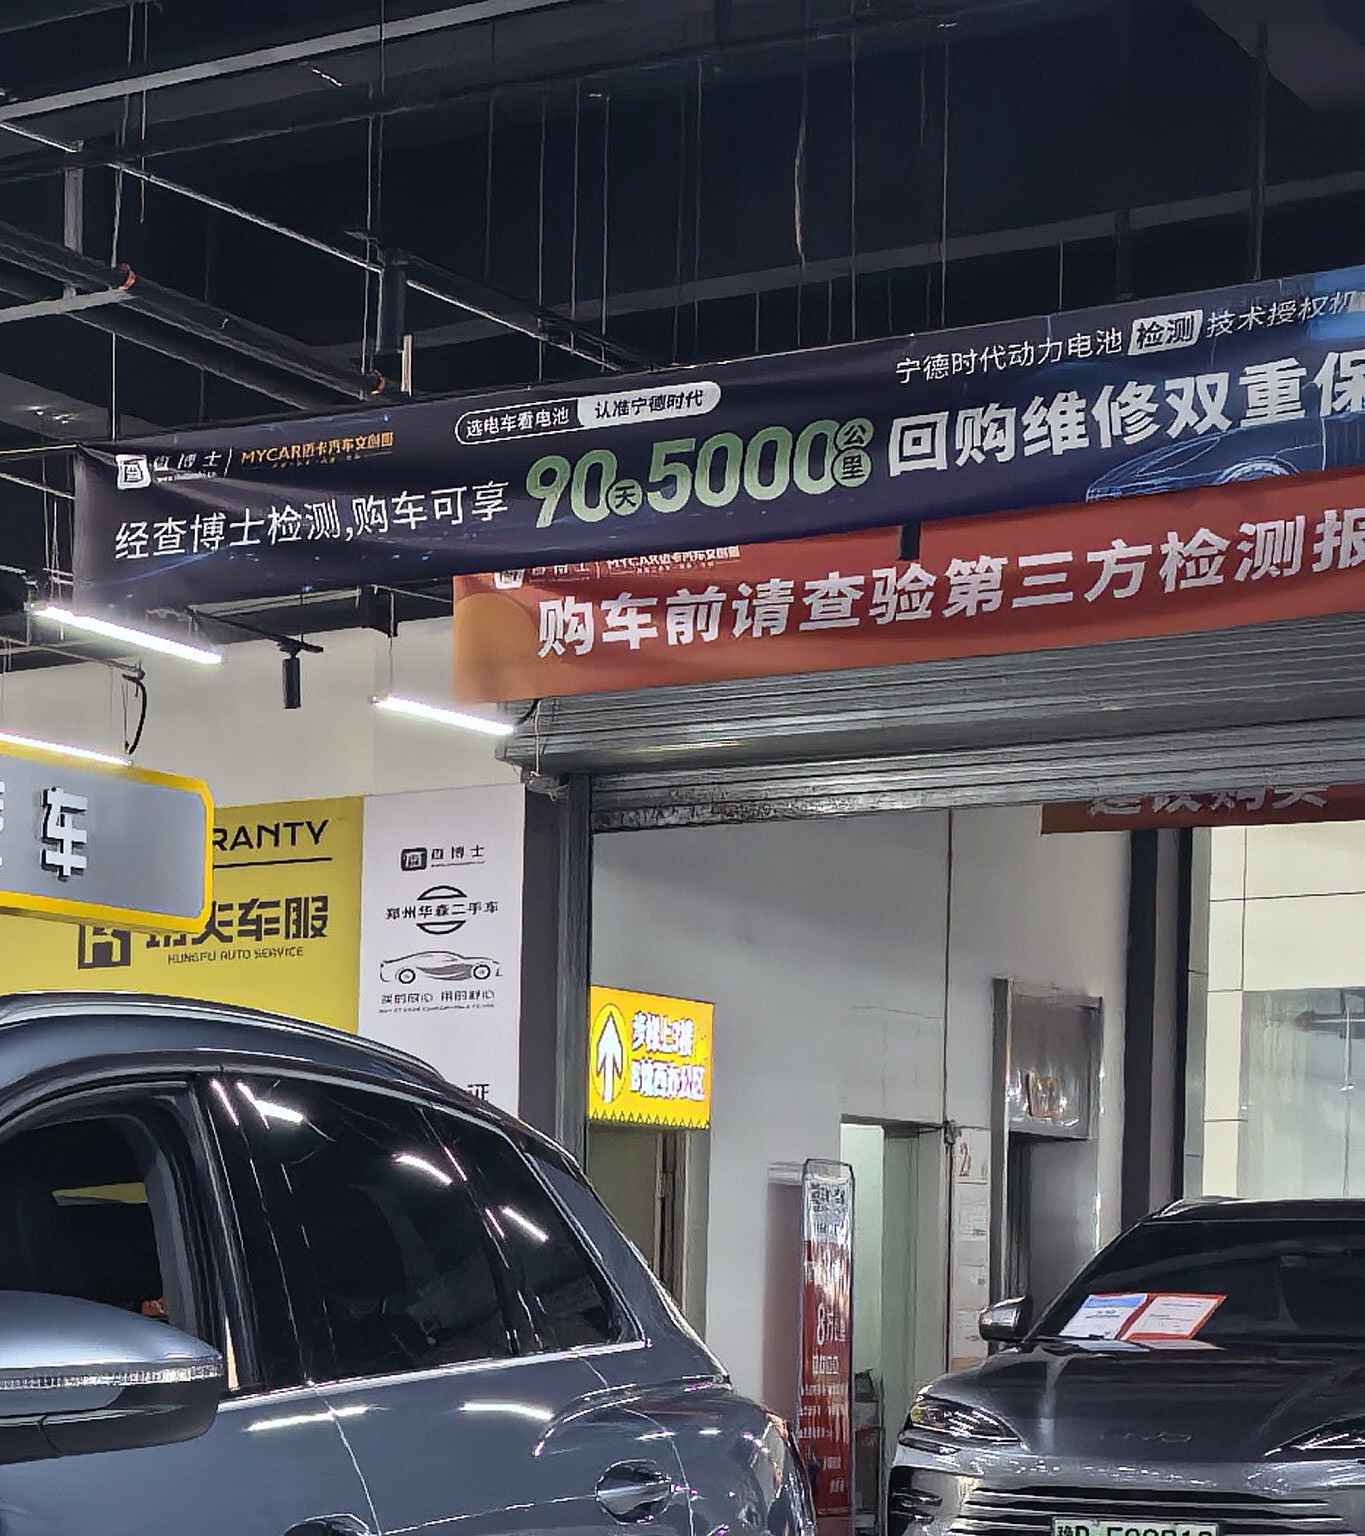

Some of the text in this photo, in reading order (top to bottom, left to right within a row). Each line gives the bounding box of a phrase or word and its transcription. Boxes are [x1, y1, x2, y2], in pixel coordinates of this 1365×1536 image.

[895, 327, 1124, 385] 宁德时代动力电池
[1135, 313, 1195, 350] 检测
[594, 390, 704, 420] 认准宁德时代
[146, 894, 330, 949] 夫车服
